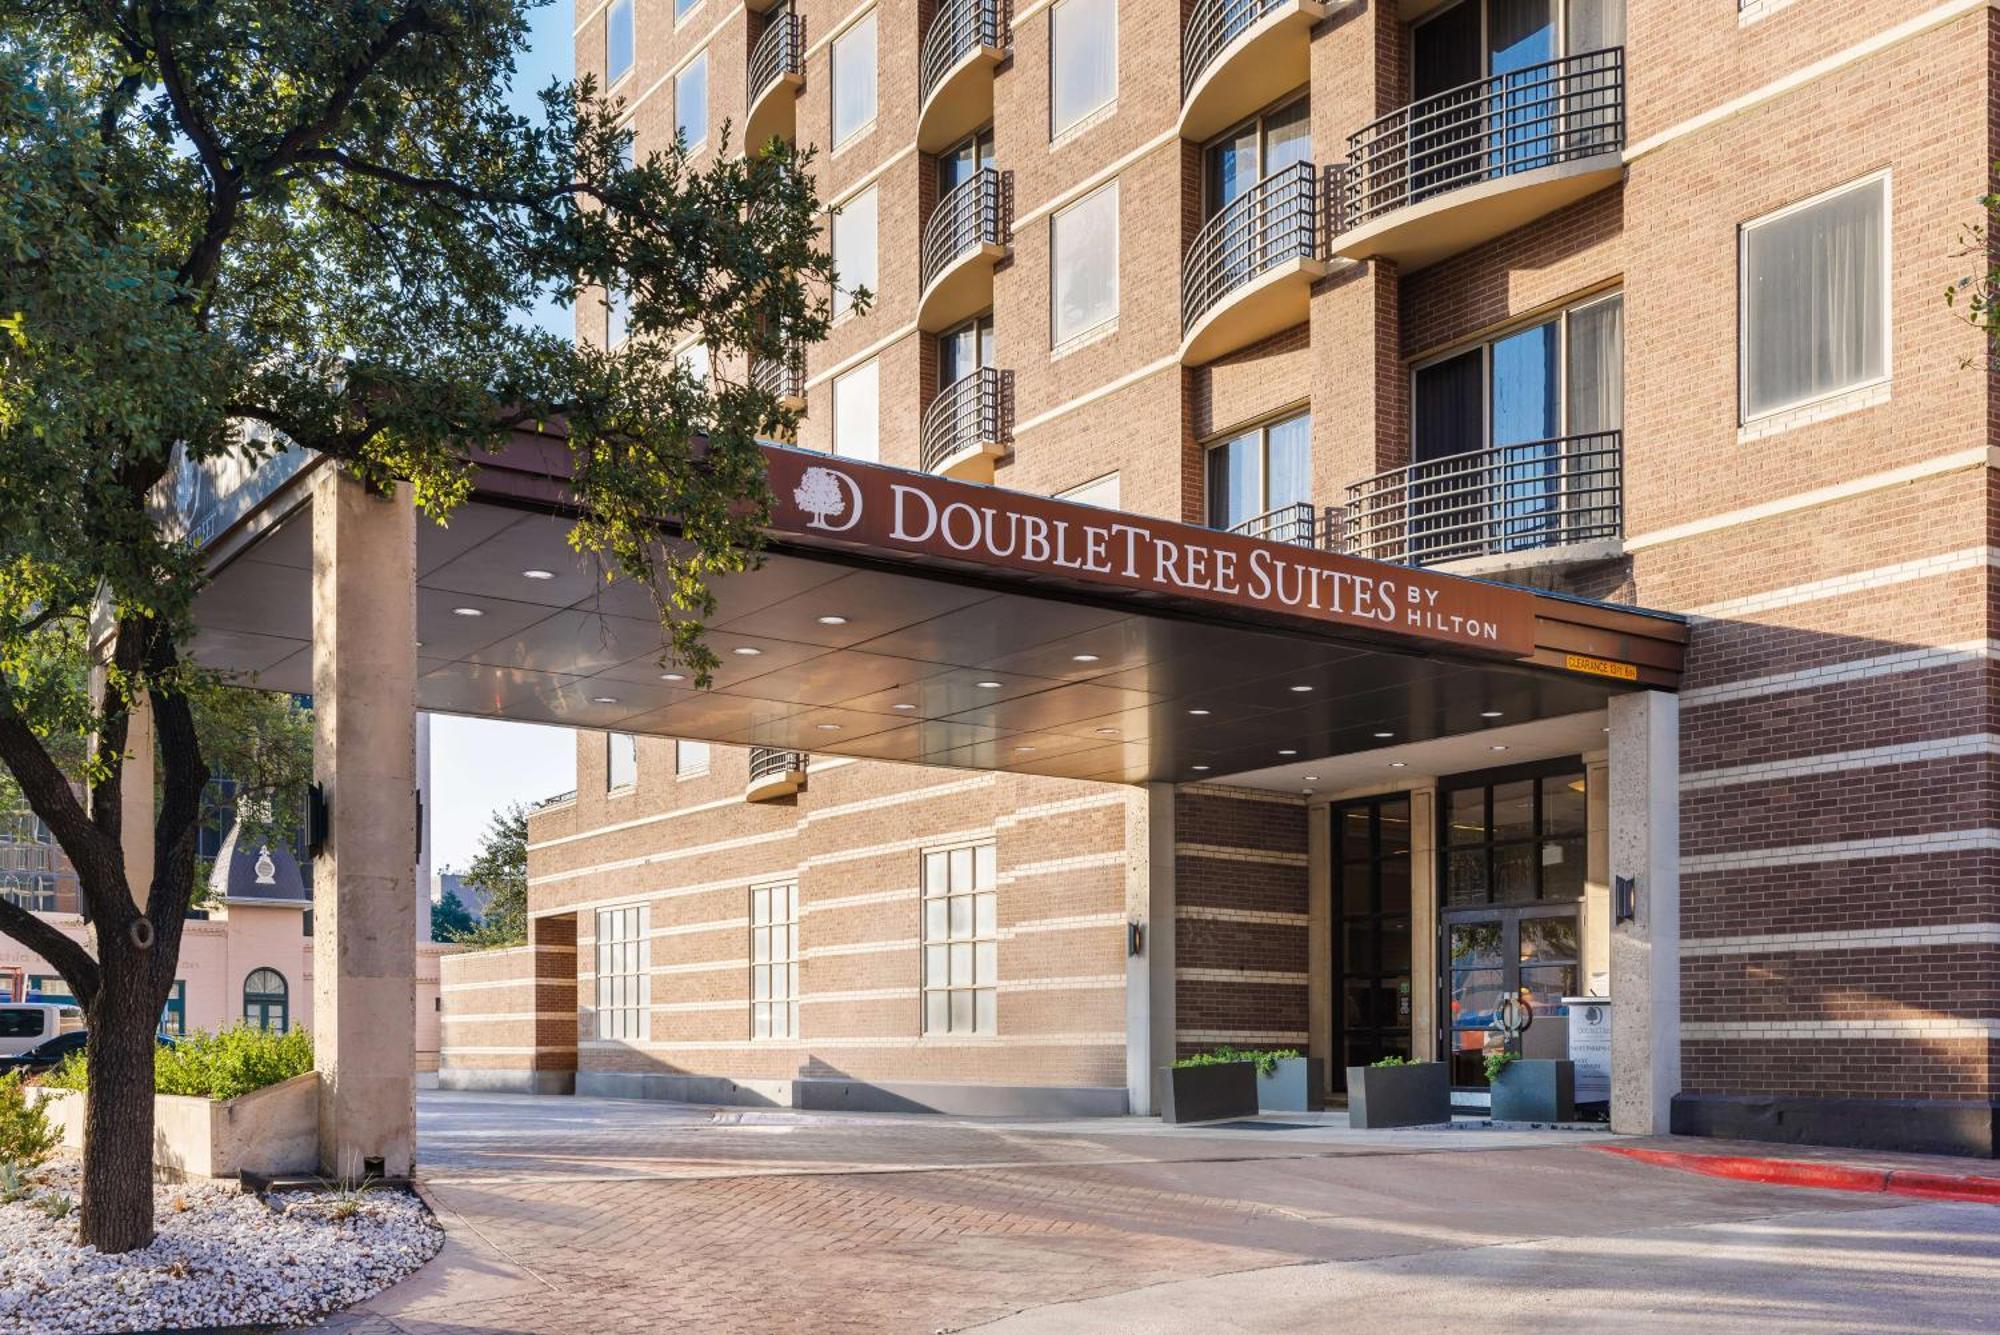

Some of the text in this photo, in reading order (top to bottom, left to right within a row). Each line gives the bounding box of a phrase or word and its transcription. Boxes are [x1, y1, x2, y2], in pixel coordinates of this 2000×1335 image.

[1247, 549, 1396, 622] SUITES
[1407, 586, 1439, 606] BY
[1407, 609, 1498, 640] HILTON
[1568, 656, 1608, 673] CLEARANCE
